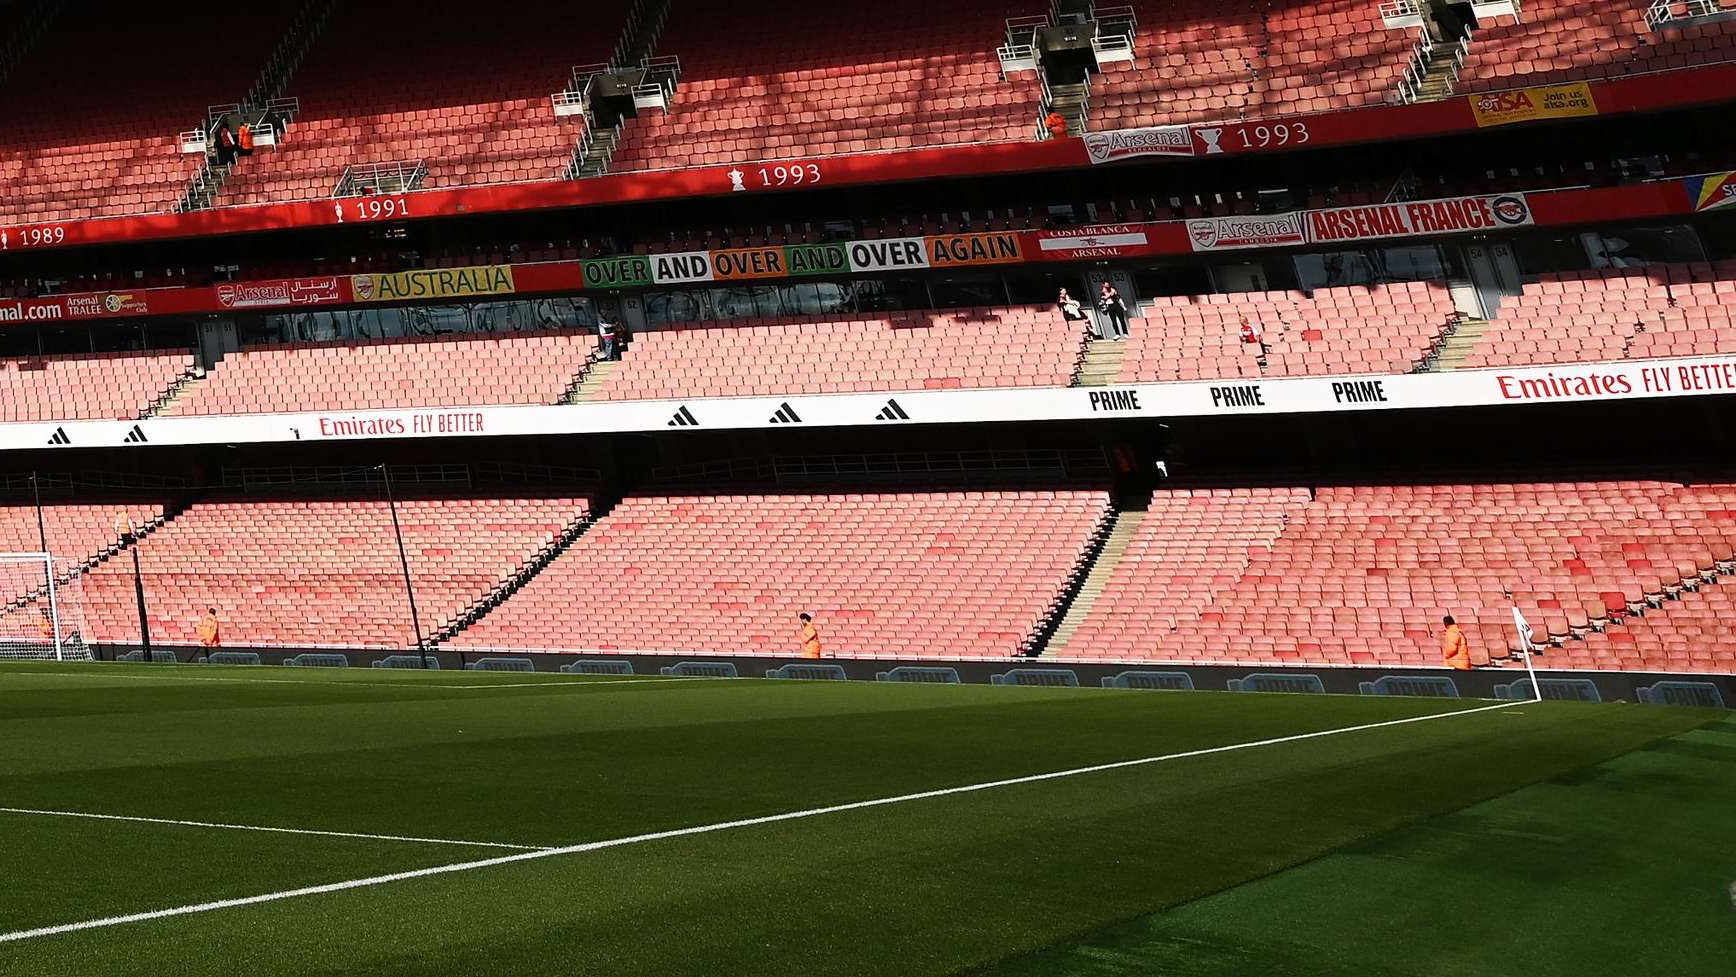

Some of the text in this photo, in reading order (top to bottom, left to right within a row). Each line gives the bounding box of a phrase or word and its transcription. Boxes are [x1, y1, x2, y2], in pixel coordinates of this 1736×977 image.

[1543, 99, 1590, 111] aisa.org
[1544, 90, 1584, 102] Join us
[1111, 127, 1191, 149] Arsenal
[1236, 122, 1310, 148] 1993
[758, 163, 822, 186] 1993
[356, 198, 409, 219] 1991
[1218, 215, 1298, 239] Arsenal
[1311, 198, 1497, 241] ARSENAL FRANCE
[20, 226, 64, 246] 1989
[1050, 225, 1130, 238] COSTA BLANCA
[584, 235, 1018, 284] OVER AND OVER AND OVER AGAIN
[1071, 248, 1121, 259] ARSENAL
[378, 267, 511, 298] AUSTRALIA
[1114, 272, 1126, 282] 53
[67, 295, 99, 306] Arsenal
[235, 281, 289, 302] Arsenal
[68, 304, 103, 316] TRALEE
[1331, 380, 1388, 404] PRIME
[1495, 364, 1736, 400] Emirates FLY BETTE
[1089, 390, 1142, 411] PRIME
[1209, 385, 1265, 408] PRIME
[319, 413, 484, 436] Emirates FLY BETTER
